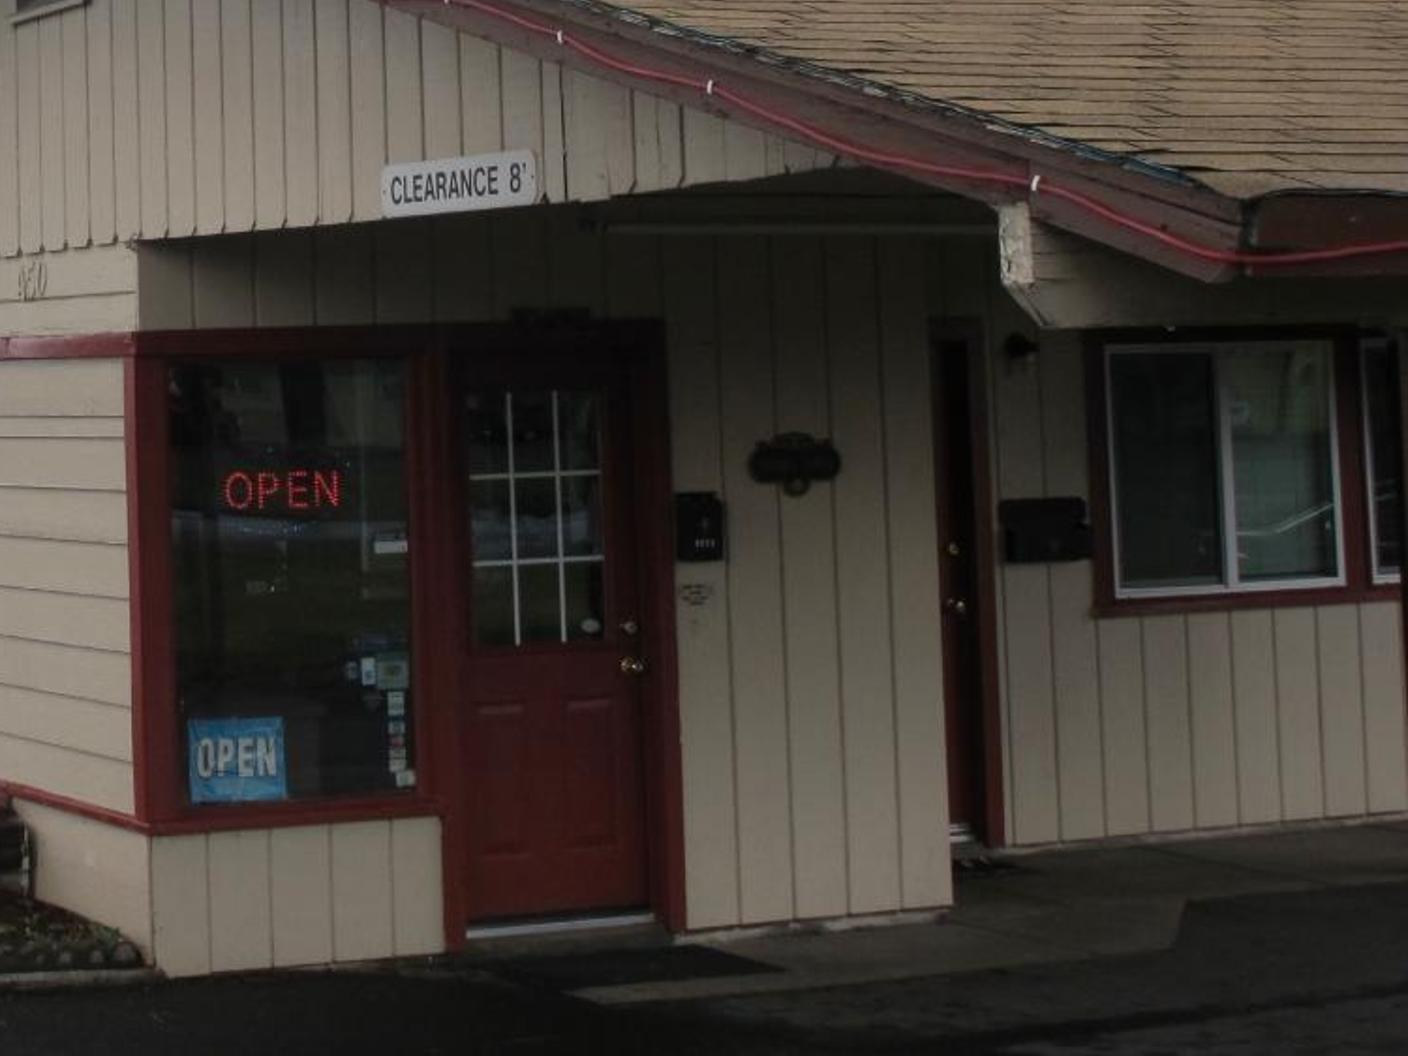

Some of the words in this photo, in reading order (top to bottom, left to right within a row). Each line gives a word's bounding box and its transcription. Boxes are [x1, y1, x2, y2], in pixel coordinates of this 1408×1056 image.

[390, 165, 499, 205] CLEARANCE
[220, 468, 343, 510] OPEN
[197, 737, 277, 778] OPEN
